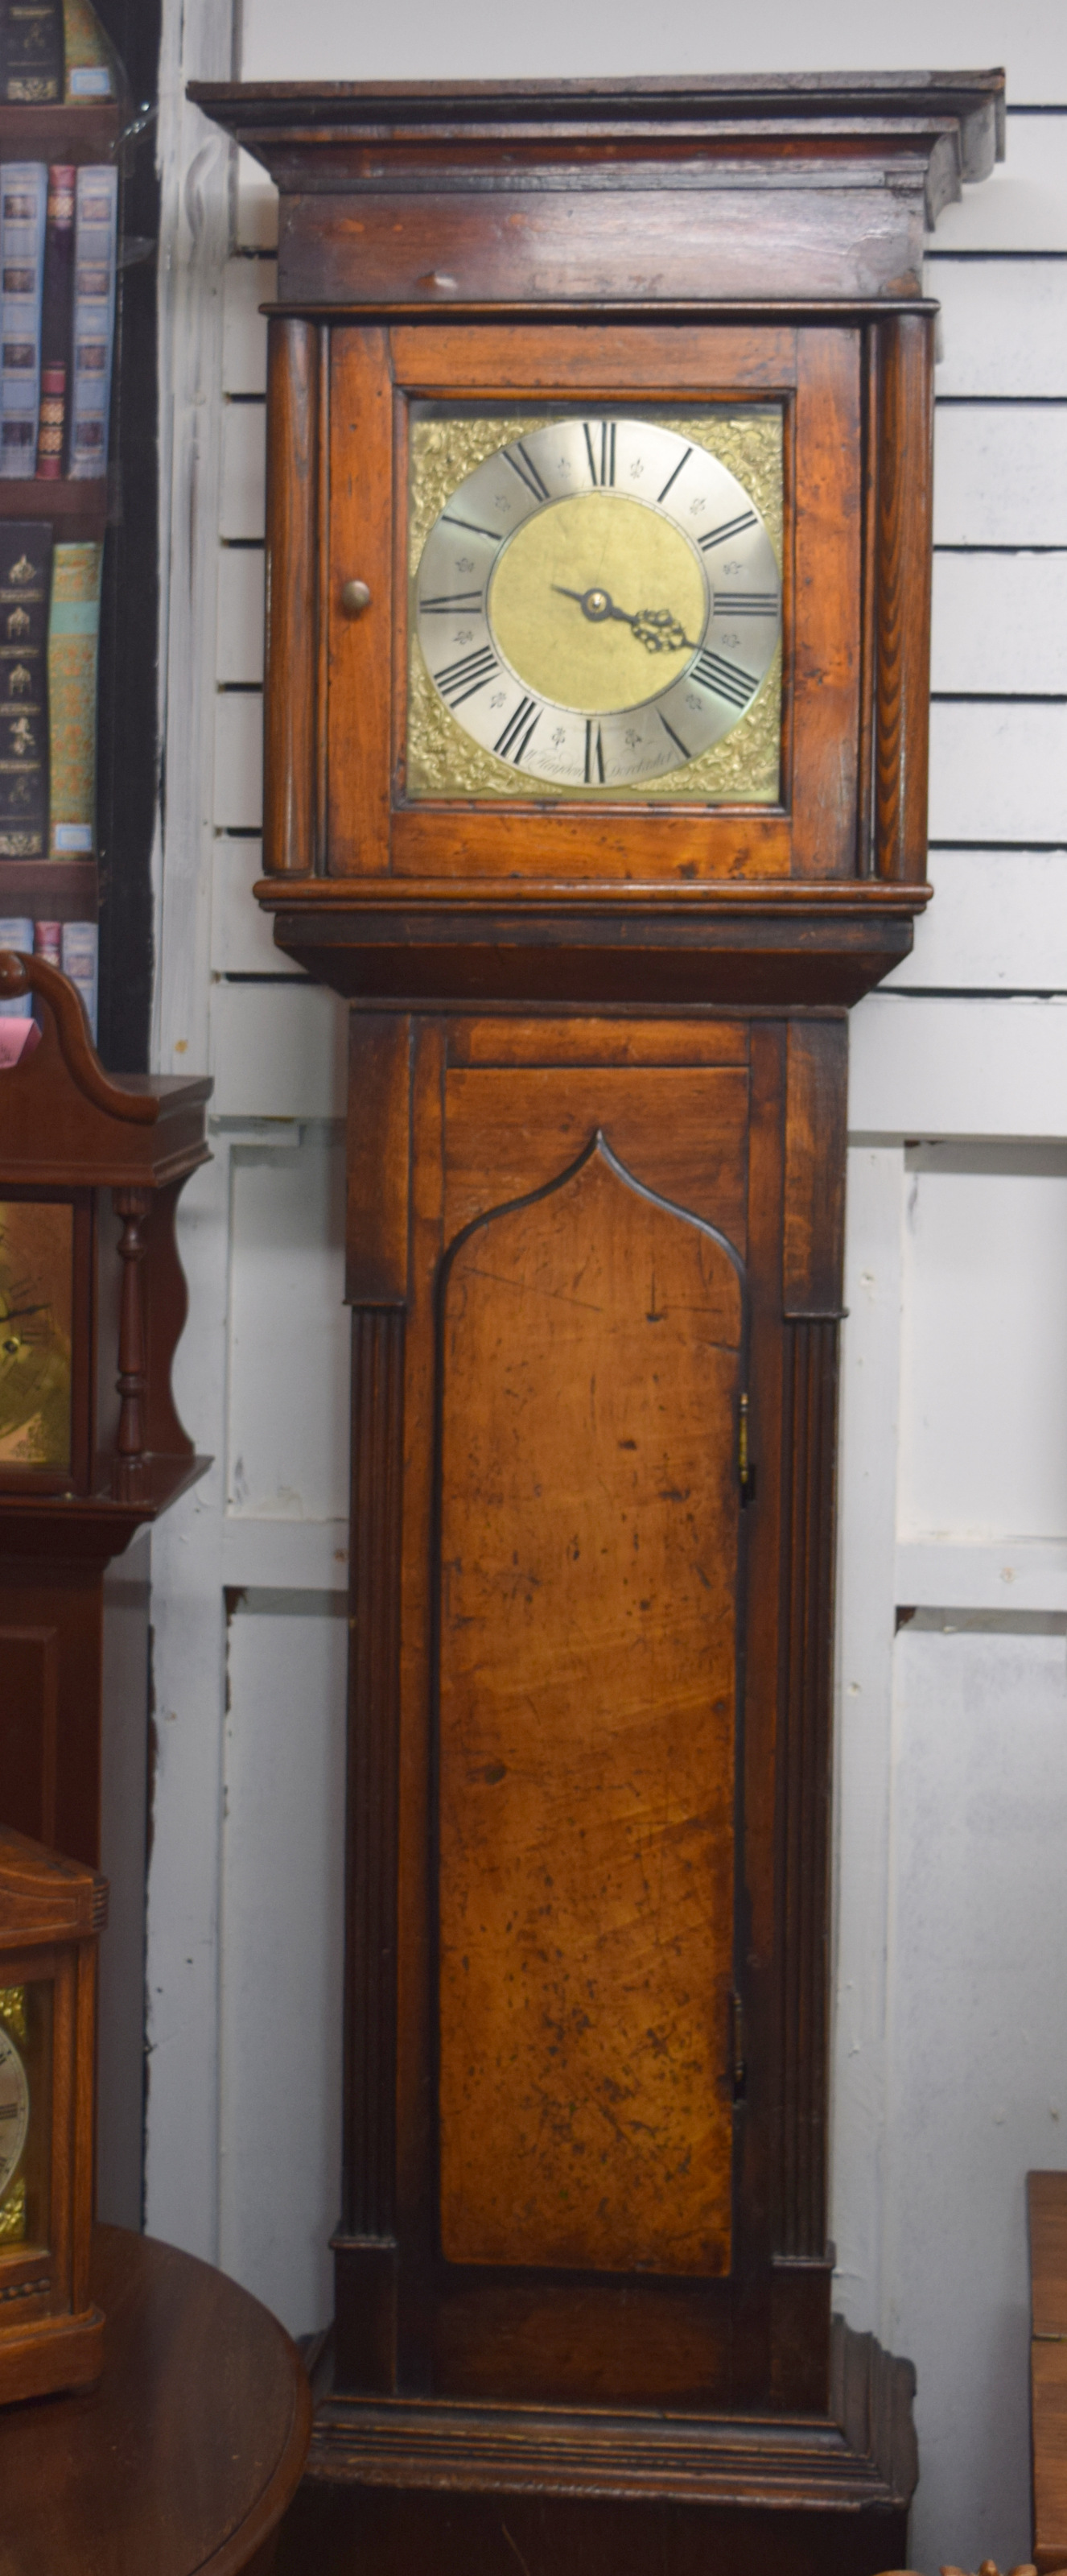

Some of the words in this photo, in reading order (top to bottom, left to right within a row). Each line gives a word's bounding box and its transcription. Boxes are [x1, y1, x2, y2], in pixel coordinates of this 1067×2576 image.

[657, 447, 693, 503] I
[697, 510, 758, 552] II
[713, 592, 778, 617] III
[434, 645, 503, 709] VIII
[690, 649, 760, 708] IIII
[493, 696, 545, 765] VII
